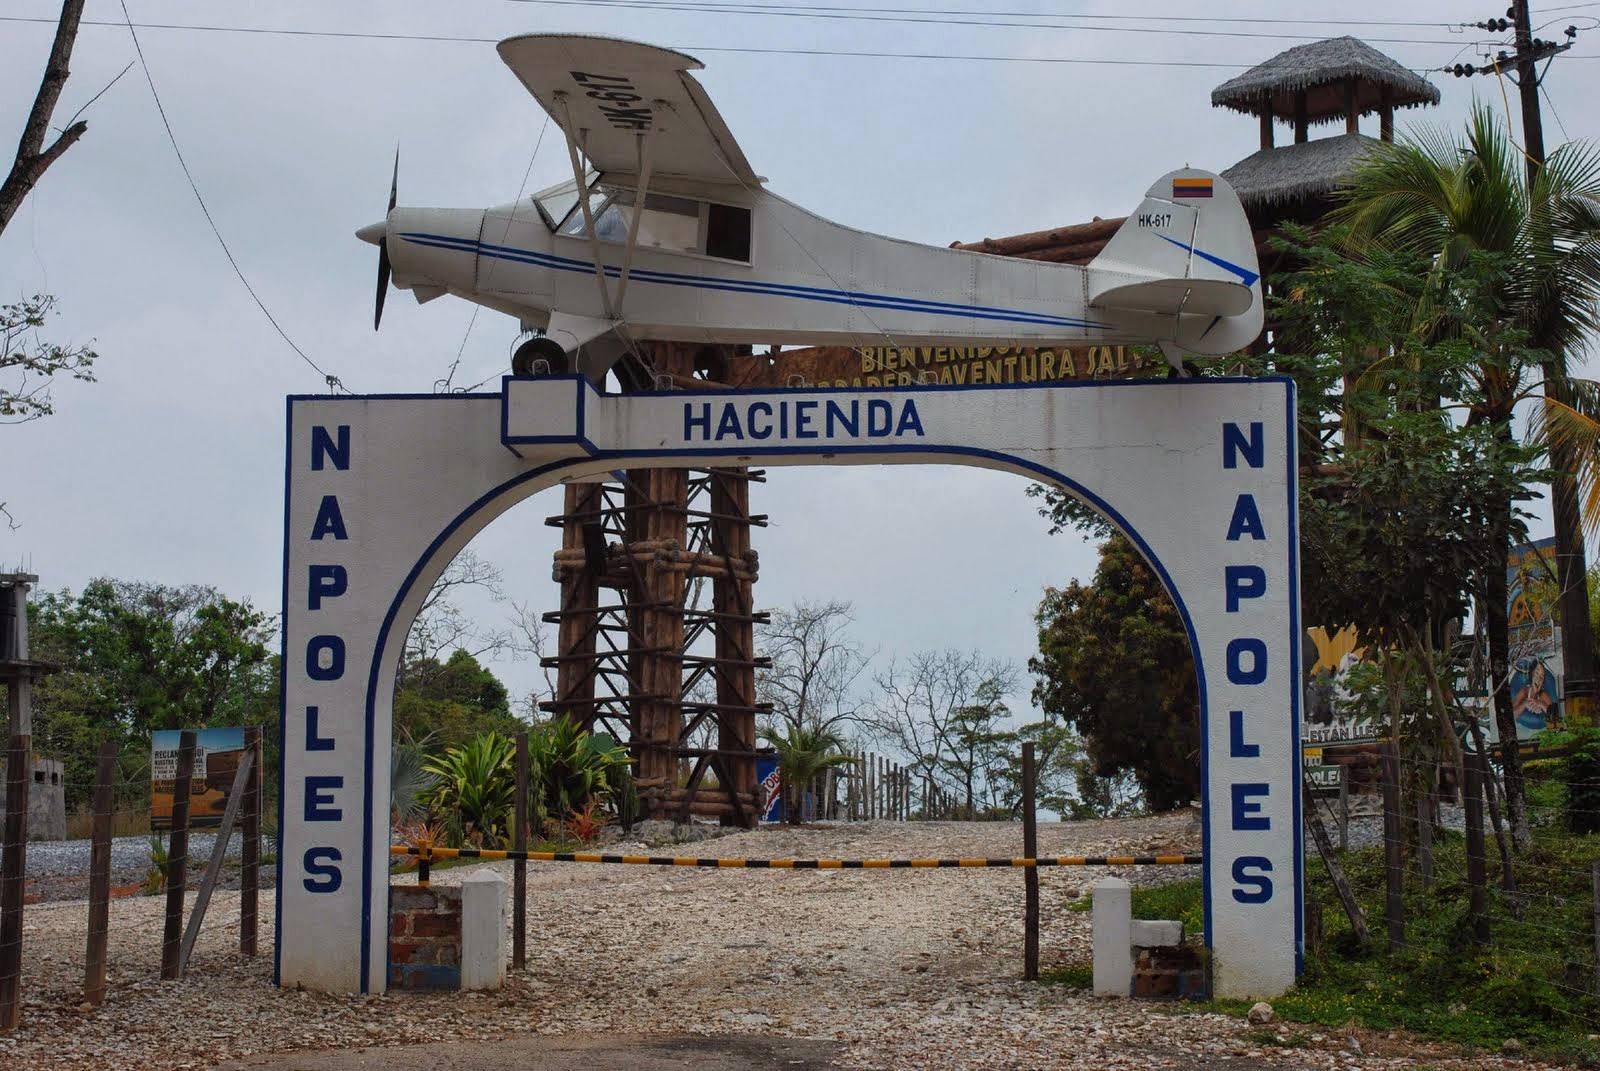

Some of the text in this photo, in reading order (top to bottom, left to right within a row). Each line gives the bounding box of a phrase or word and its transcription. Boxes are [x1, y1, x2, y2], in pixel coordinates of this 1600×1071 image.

[568, 71, 653, 130] HK-617
[1138, 214, 1172, 228] HK-617
[940, 349, 1076, 385] AVENTURA
[684, 398, 925, 440] HACIENDA
[303, 425, 350, 893] NAPOLES
[1223, 422, 1274, 905] NAPOLES
